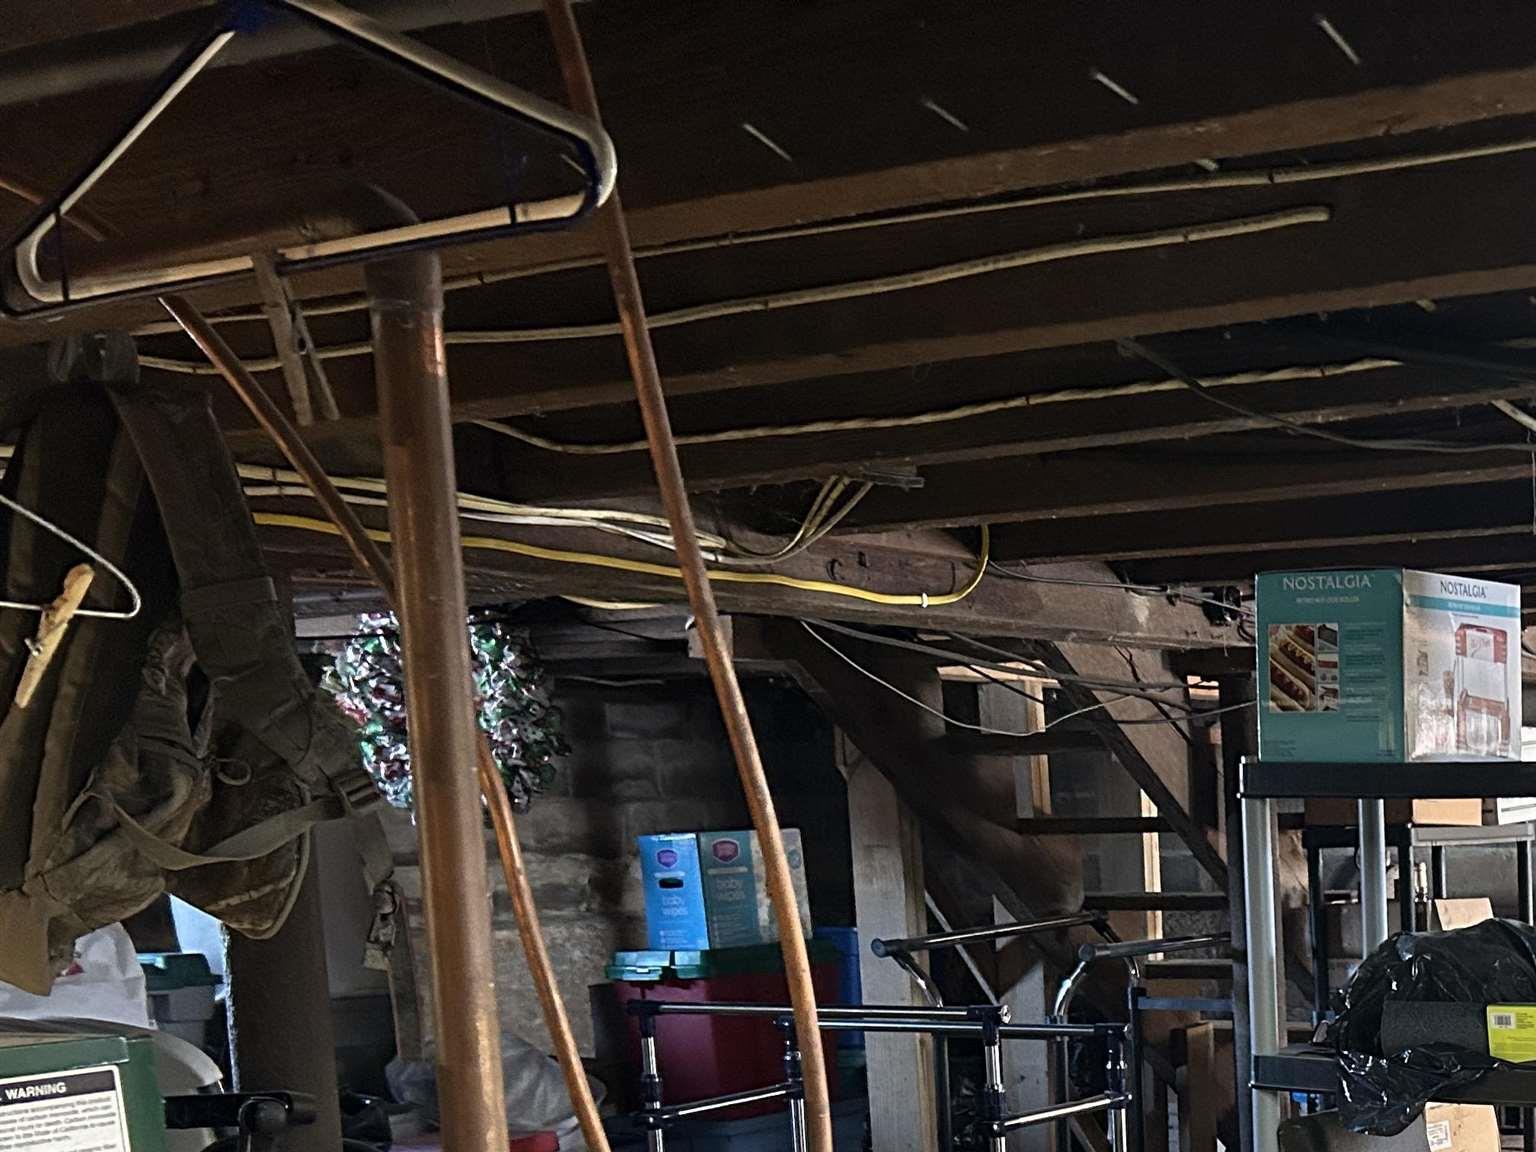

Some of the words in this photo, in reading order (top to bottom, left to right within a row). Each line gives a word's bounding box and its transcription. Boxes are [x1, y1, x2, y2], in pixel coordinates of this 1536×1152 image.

[1283, 574, 1371, 590] NOSTALGIA
[1440, 580, 1487, 599] NOSTALGIA
[5, 1081, 67, 1100] WARNING
